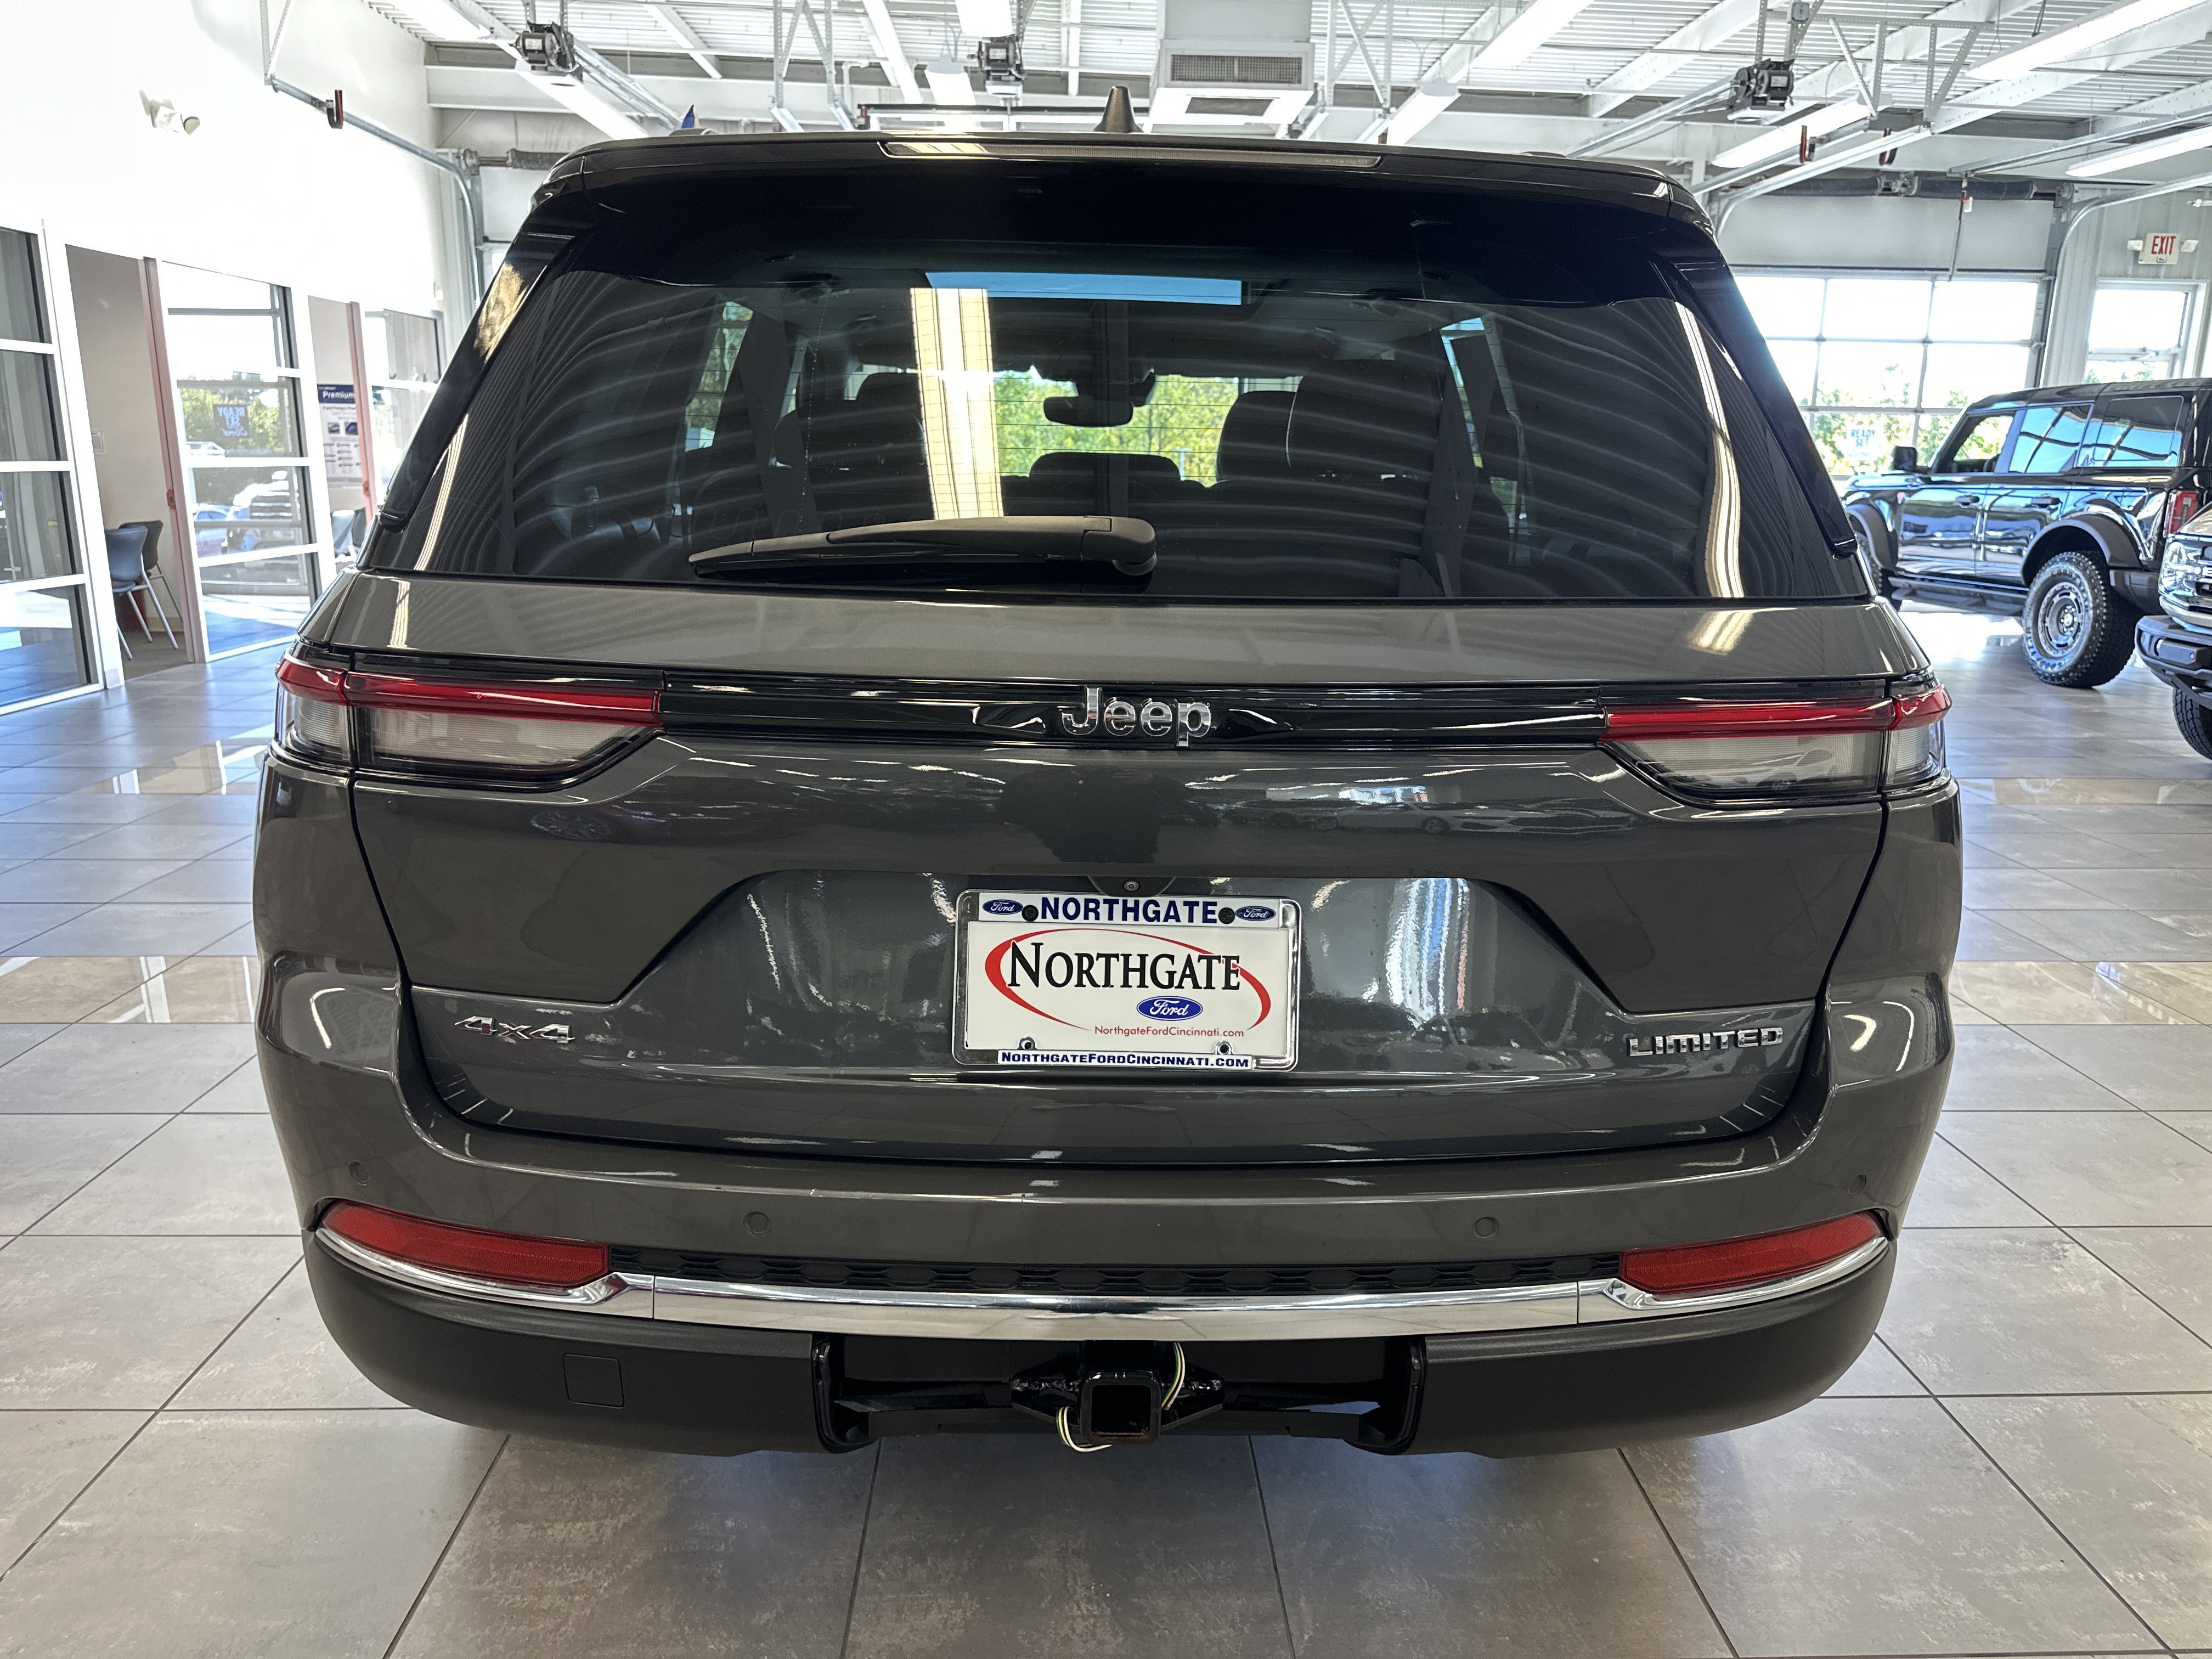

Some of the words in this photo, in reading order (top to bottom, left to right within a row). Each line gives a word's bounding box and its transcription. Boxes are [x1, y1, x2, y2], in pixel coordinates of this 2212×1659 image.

[2151, 236, 2176, 255] EXIT
[1058, 686, 1212, 747] Jeep
[990, 901, 1015, 912] Ford
[1041, 897, 1217, 924] NORTHGATE
[1243, 908, 1268, 918] Ford
[1007, 941, 1240, 990] NORTHGATE
[1149, 999, 1190, 1016] Ford
[1094, 1026, 1244, 1037] NorthgateFordCincinnati.com
[1627, 1026, 1784, 1057] LIMITED
